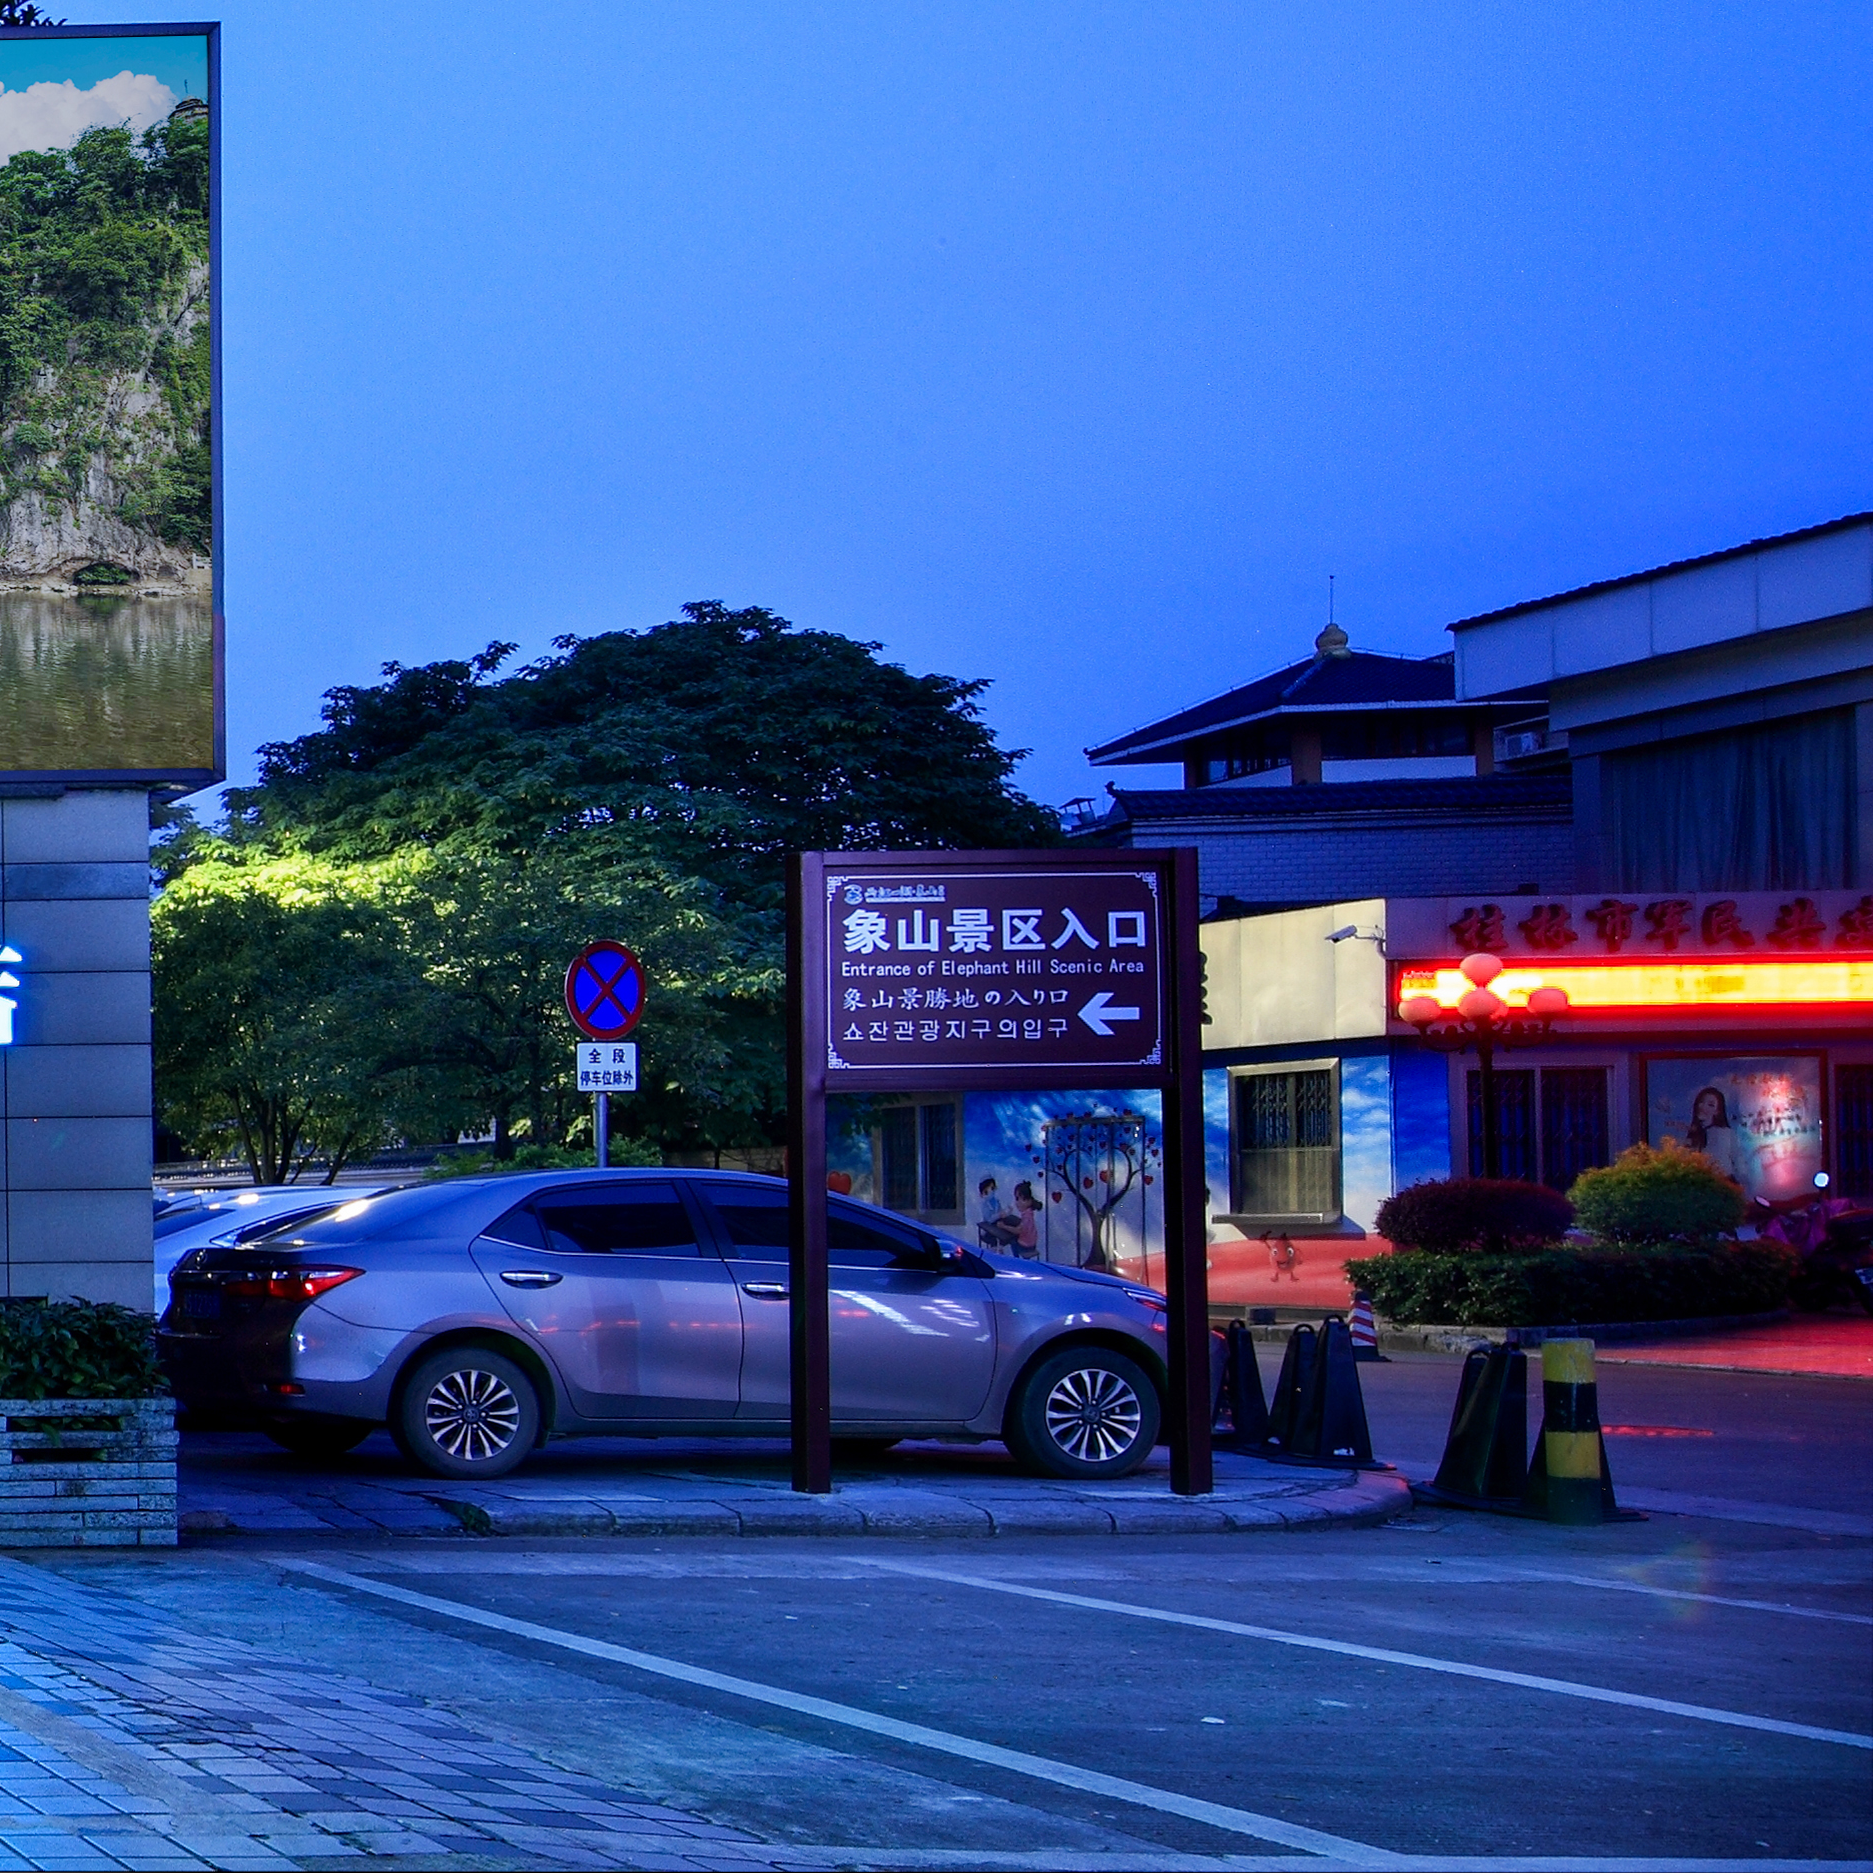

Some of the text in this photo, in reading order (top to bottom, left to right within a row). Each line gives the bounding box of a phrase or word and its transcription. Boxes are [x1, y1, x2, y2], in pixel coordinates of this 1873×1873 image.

[842, 908, 1147, 955] 象山景区入口
[840, 958, 1145, 978] Entrance of Elephant Hill Scenic Area
[842, 987, 1069, 1012] 象山景勝地の入り口
[842, 1018, 1069, 1042] 쇼잔관광지구의입구
[588, 1048, 626, 1064] 全段
[579, 1070, 634, 1086] 停车位除外
